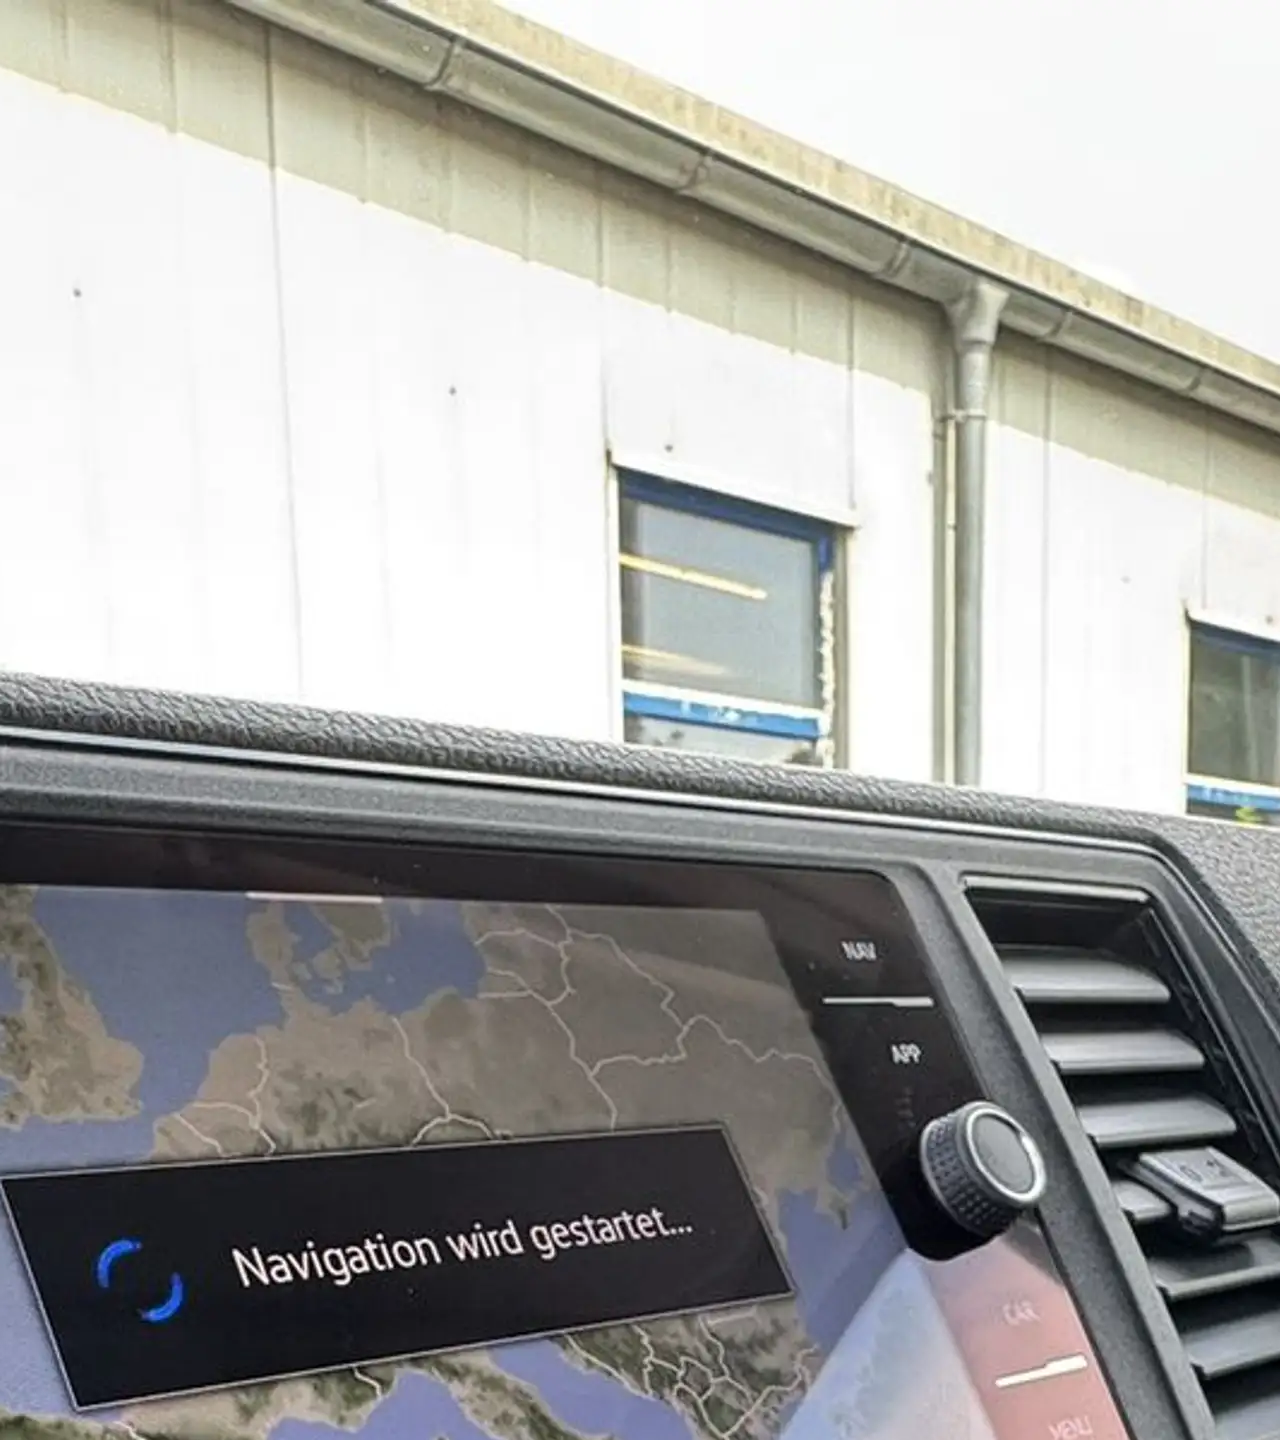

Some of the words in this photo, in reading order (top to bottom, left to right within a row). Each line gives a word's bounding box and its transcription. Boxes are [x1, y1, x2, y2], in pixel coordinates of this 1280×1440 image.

[840, 940, 878, 961] NAV
[890, 1042, 923, 1064] APP
[231, 1233, 442, 1288] Navigation
[446, 1214, 525, 1262] wird
[529, 1206, 694, 1261] gestartet...
